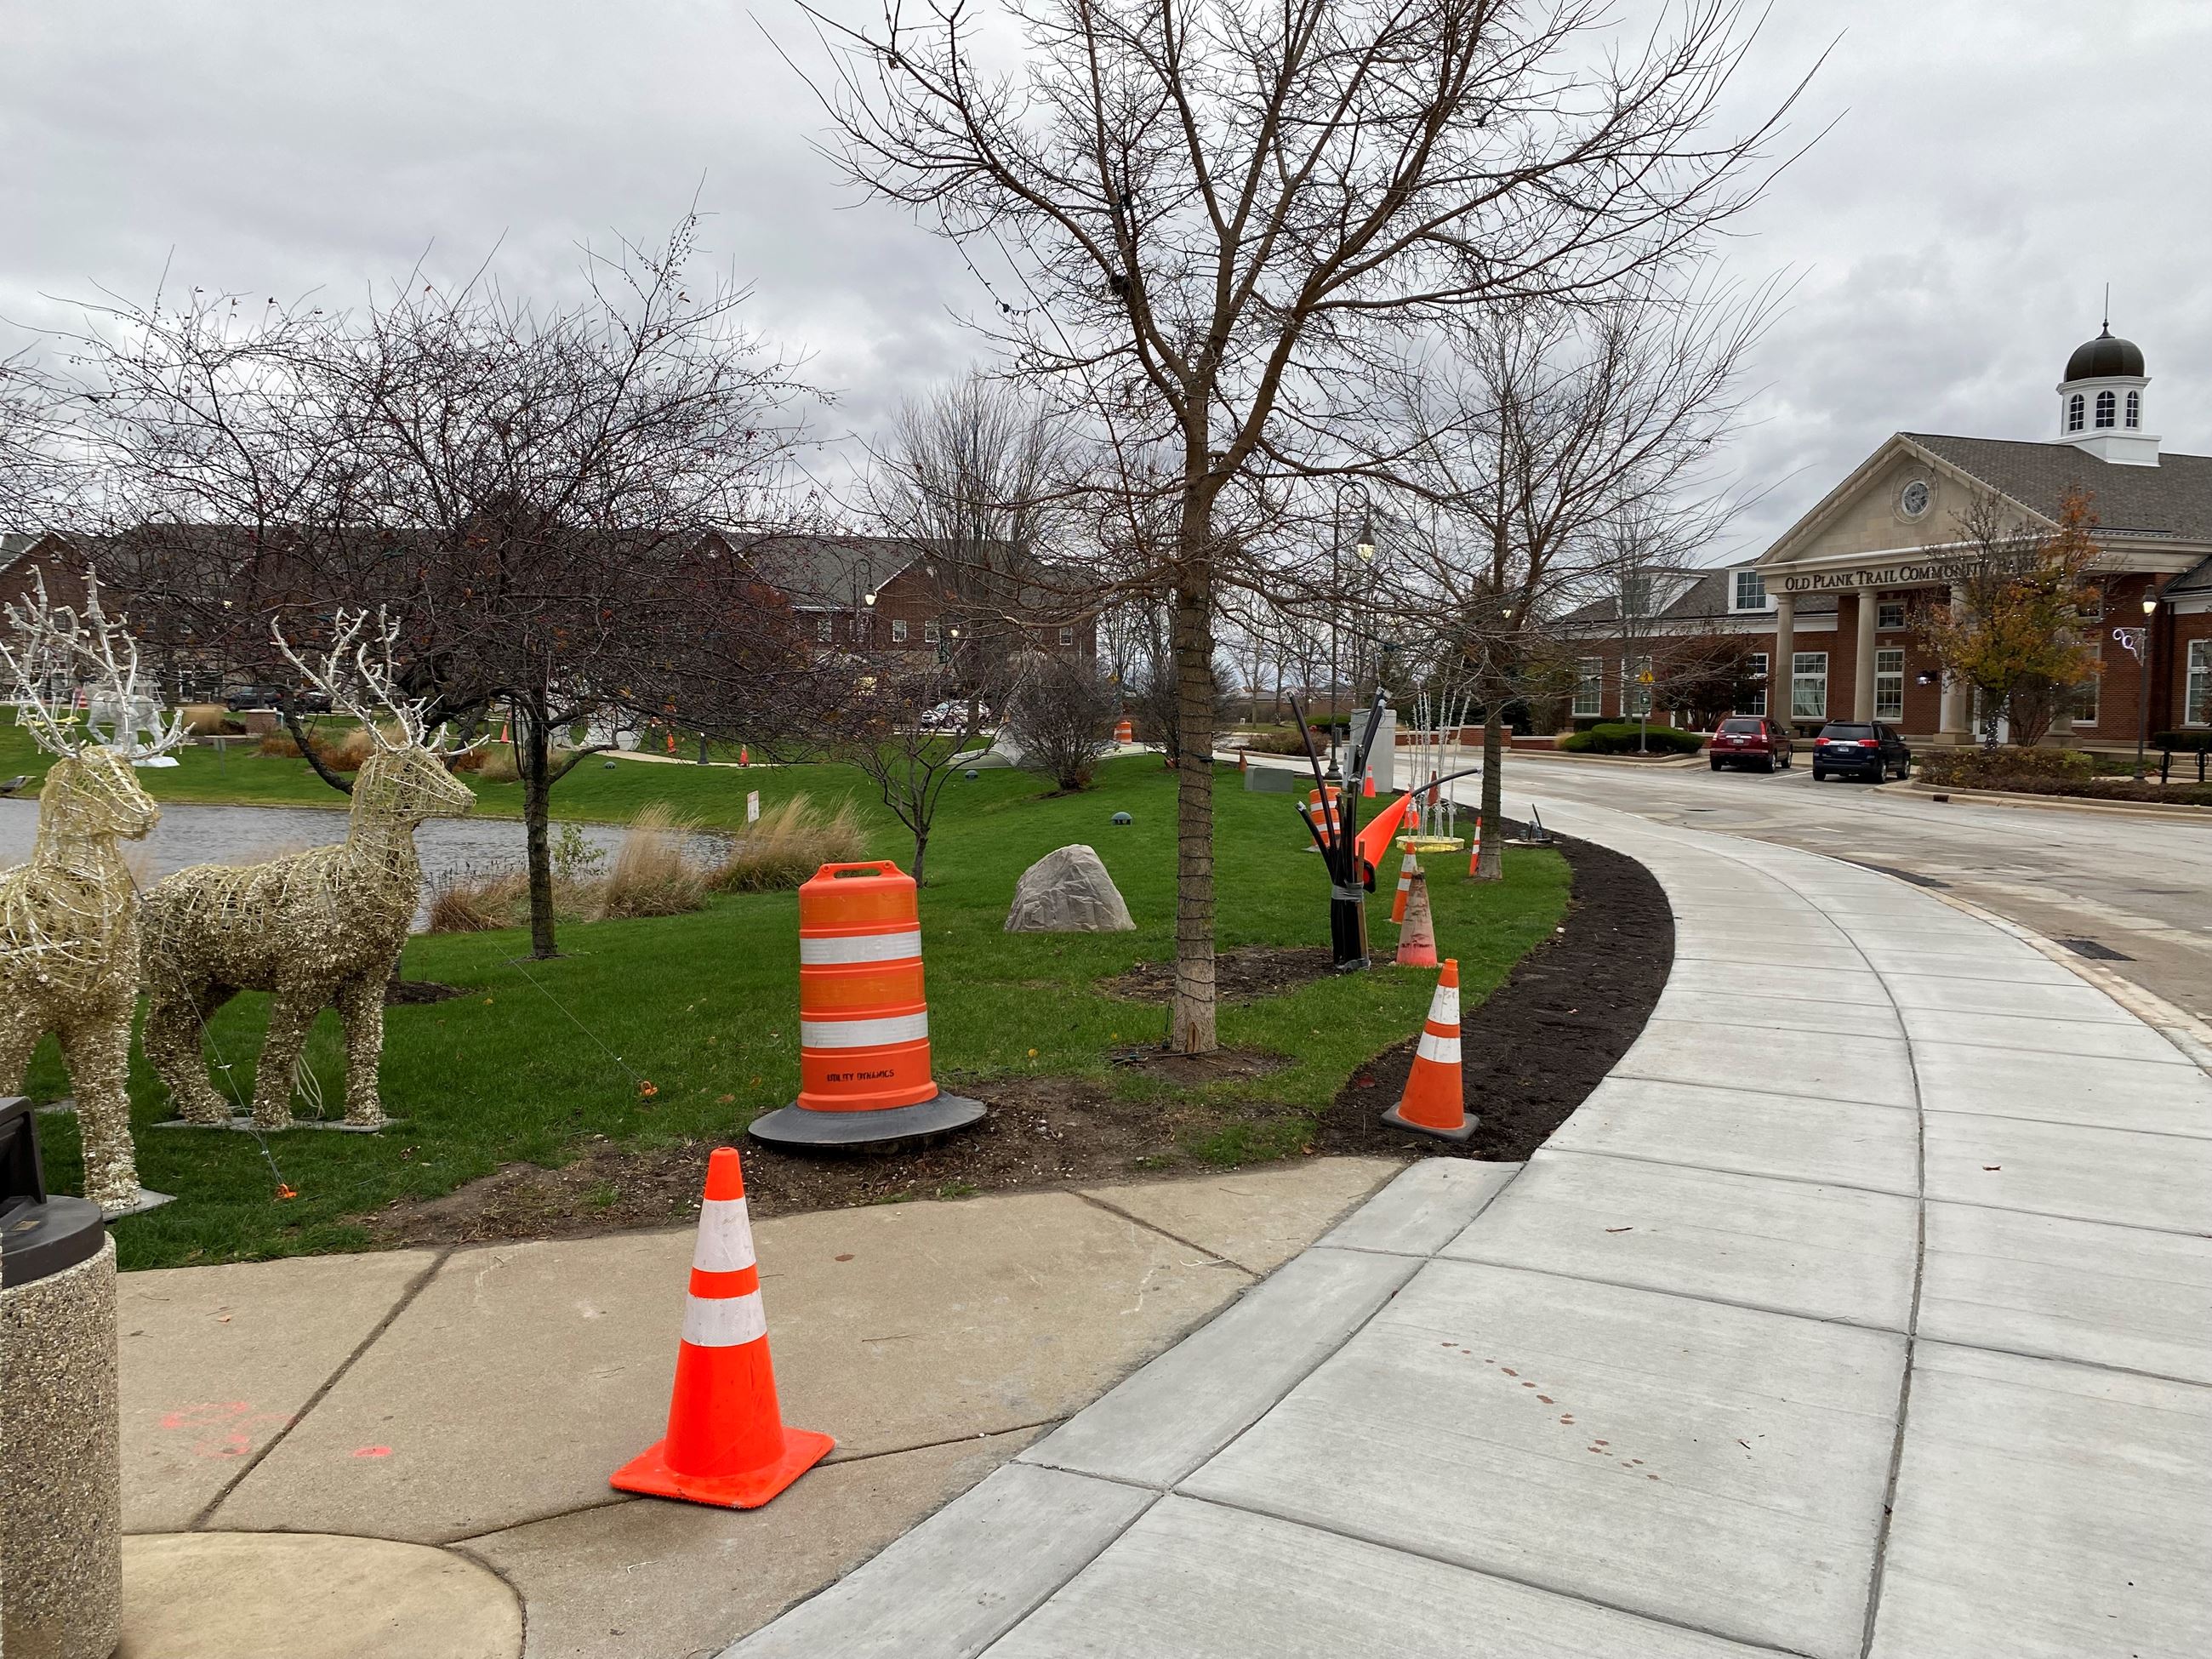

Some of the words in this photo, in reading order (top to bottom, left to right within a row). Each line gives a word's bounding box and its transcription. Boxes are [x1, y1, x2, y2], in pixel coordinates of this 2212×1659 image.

[1785, 577, 1810, 590] OLD
[1813, 573, 1855, 589] PLANK
[1856, 570, 1897, 585] TRAIL
[827, 1073, 853, 1082] UTILITY
[857, 1069, 894, 1080] DYNAMICS
